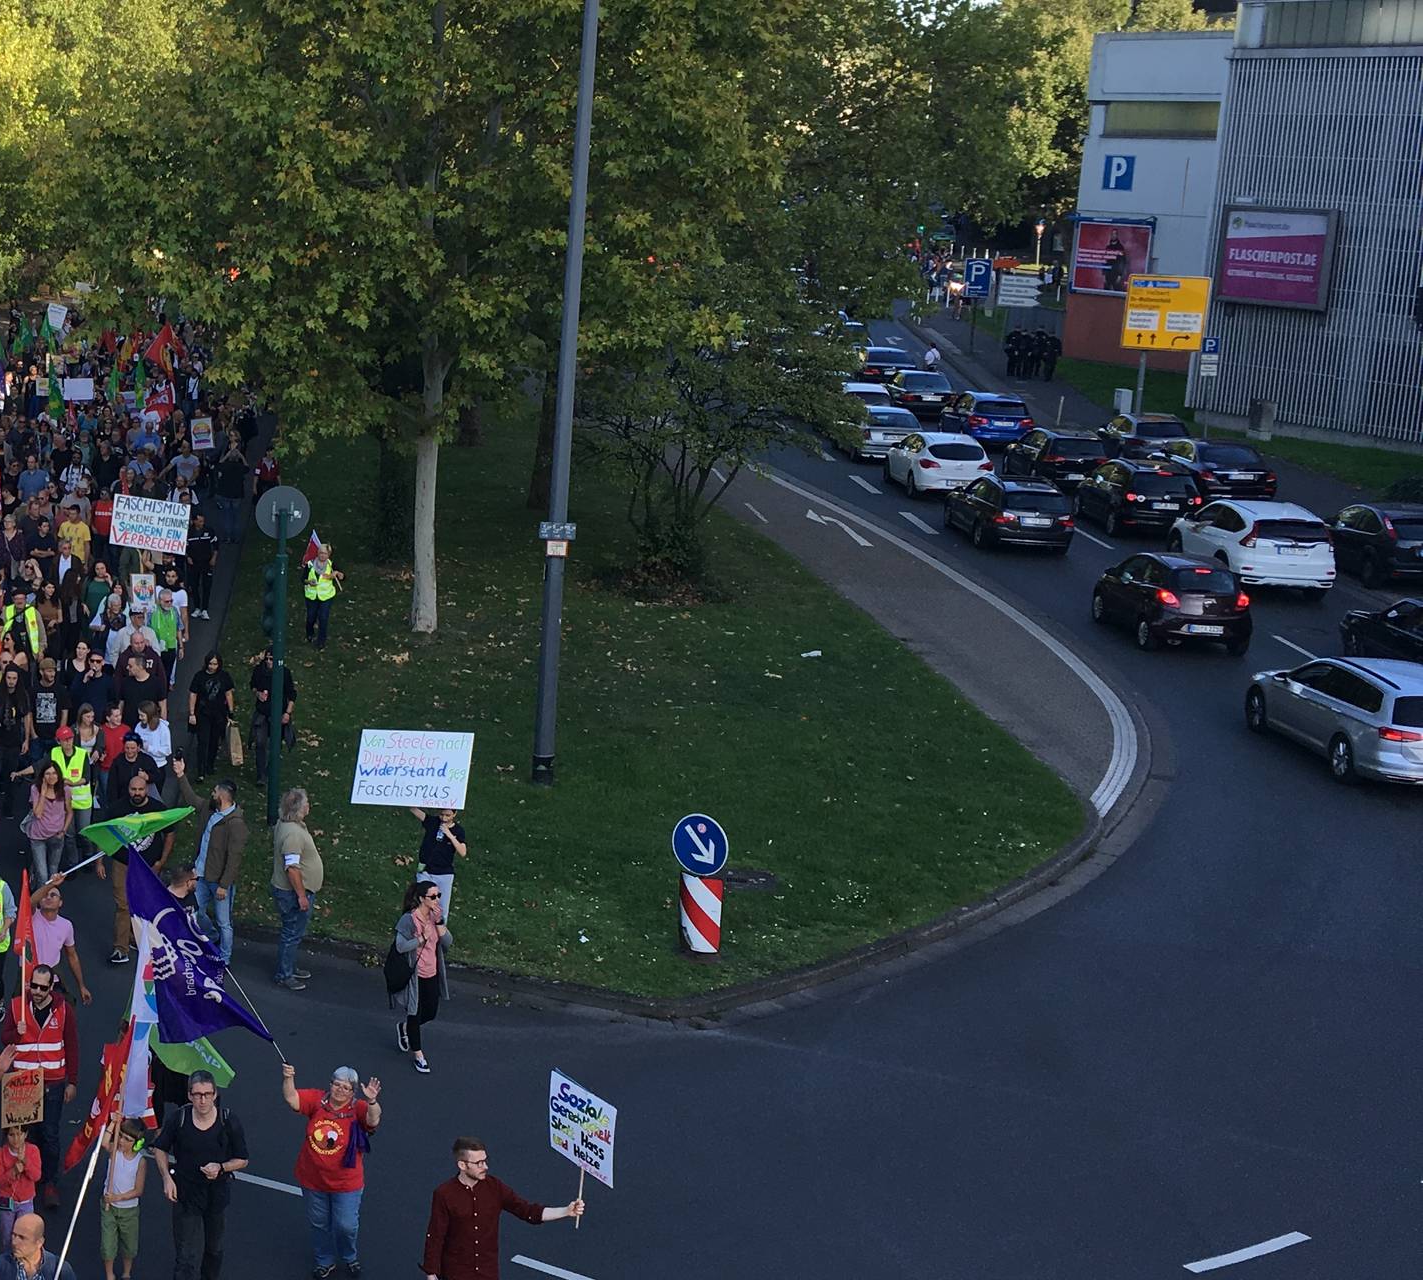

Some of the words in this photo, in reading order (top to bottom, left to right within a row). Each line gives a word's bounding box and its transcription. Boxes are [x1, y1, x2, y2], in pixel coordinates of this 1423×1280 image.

[1109, 157, 1127, 188] P
[1229, 248, 1317, 266] FLASCHENPOST.DE
[971, 264, 985, 282] P
[1205, 339, 1216, 352] P
[115, 496, 188, 517] FASCHISMUS
[114, 511, 127, 521] IST
[129, 513, 154, 525] KEINE
[112, 526, 185, 553] VERBRECHEN
[119, 521, 163, 536] SONDERN
[166, 529, 182, 540] EIN
[364, 735, 386, 748] Von
[386, 732, 435, 749] Steele
[357, 779, 450, 799] Faschismus
[581, 1131, 605, 1160] Hass
[573, 1143, 601, 1170] Hetze
